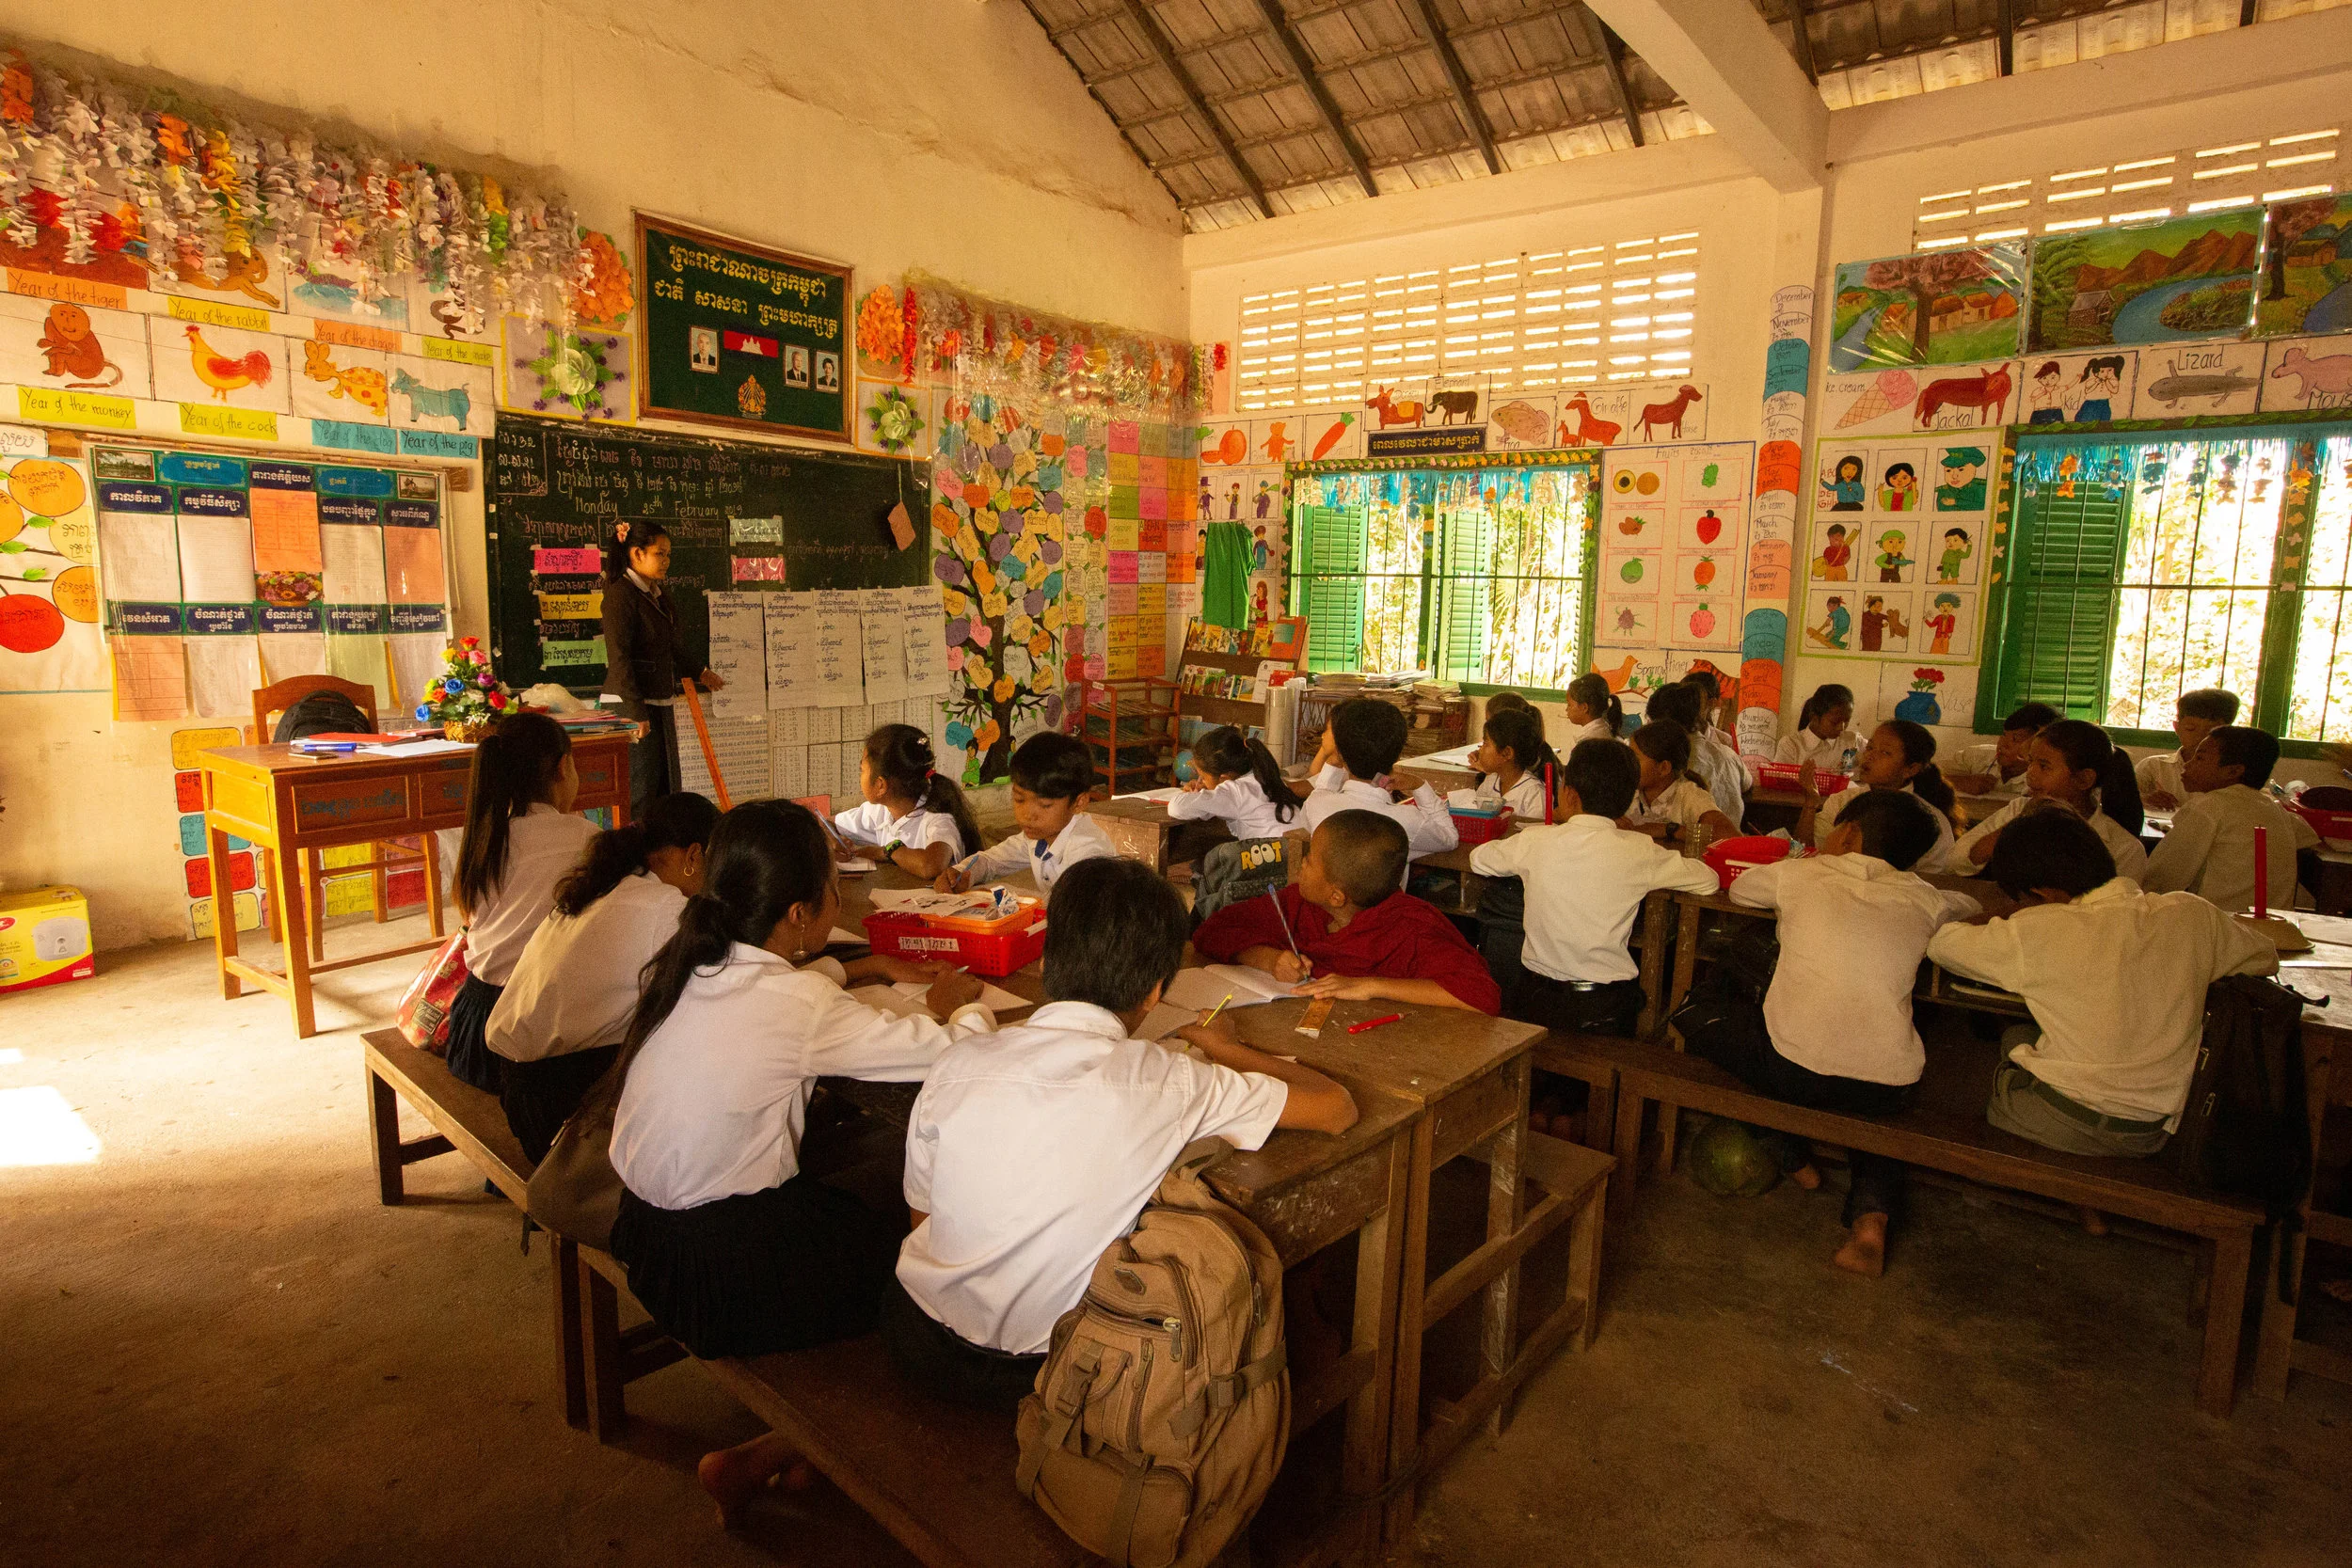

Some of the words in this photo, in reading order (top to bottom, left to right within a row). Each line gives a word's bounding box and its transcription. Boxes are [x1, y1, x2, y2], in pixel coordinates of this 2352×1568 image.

[670, 245, 826, 307] ព្រះរាជាណាចក្រកម្ពុជា
[8, 273, 41, 295] Year
[48, 282, 58, 298] of
[65, 285, 87, 300] the
[90, 291, 121, 309] tiger
[1775, 290, 1812, 302] December
[172, 299, 197, 320] Year
[203, 309, 214, 325] of
[215, 311, 232, 325] the
[235, 312, 268, 329] rabbit
[655, 278, 684, 301] ជាតិ
[694, 291, 748, 314] សាសនា
[758, 304, 837, 339] ព្រះមហាក្សត្រ
[1772, 314, 1809, 329] November
[315, 323, 336, 341] Year
[341, 330, 351, 345] of
[352, 330, 366, 344] the
[424, 340, 442, 357] Year
[446, 346, 453, 360] of
[456, 344, 467, 358] the
[2177, 344, 2223, 372] Lizard
[1825, 381, 1836, 393] ice
[1838, 382, 1867, 393] cream
[22, 389, 48, 408] Year
[55, 397, 64, 415] of
[70, 396, 87, 413] the
[92, 405, 132, 421] monkey
[2063, 392, 2081, 411] Kid
[2308, 389, 2352, 409] Mous
[181, 404, 207, 427] Year
[213, 414, 225, 434] of
[227, 416, 242, 430] the
[1934, 406, 1974, 431] Jackal
[402, 430, 425, 449] Year
[429, 434, 438, 452] of
[441, 435, 457, 450] the
[459, 440, 473, 458] pig
[1656, 447, 1679, 460] Fruits
[110, 490, 162, 505] កាលវិភាគ
[184, 494, 241, 512] កម្មវិធីសិក្សា
[575, 490, 618, 521] Monday
[675, 499, 719, 520] February
[1818, 499, 1837, 509] GH
[1820, 490, 1835, 499] DE
[1749, 569, 1778, 581] January
[1941, 689, 1972, 713] Vase
[1241, 841, 1282, 870] ROOT
